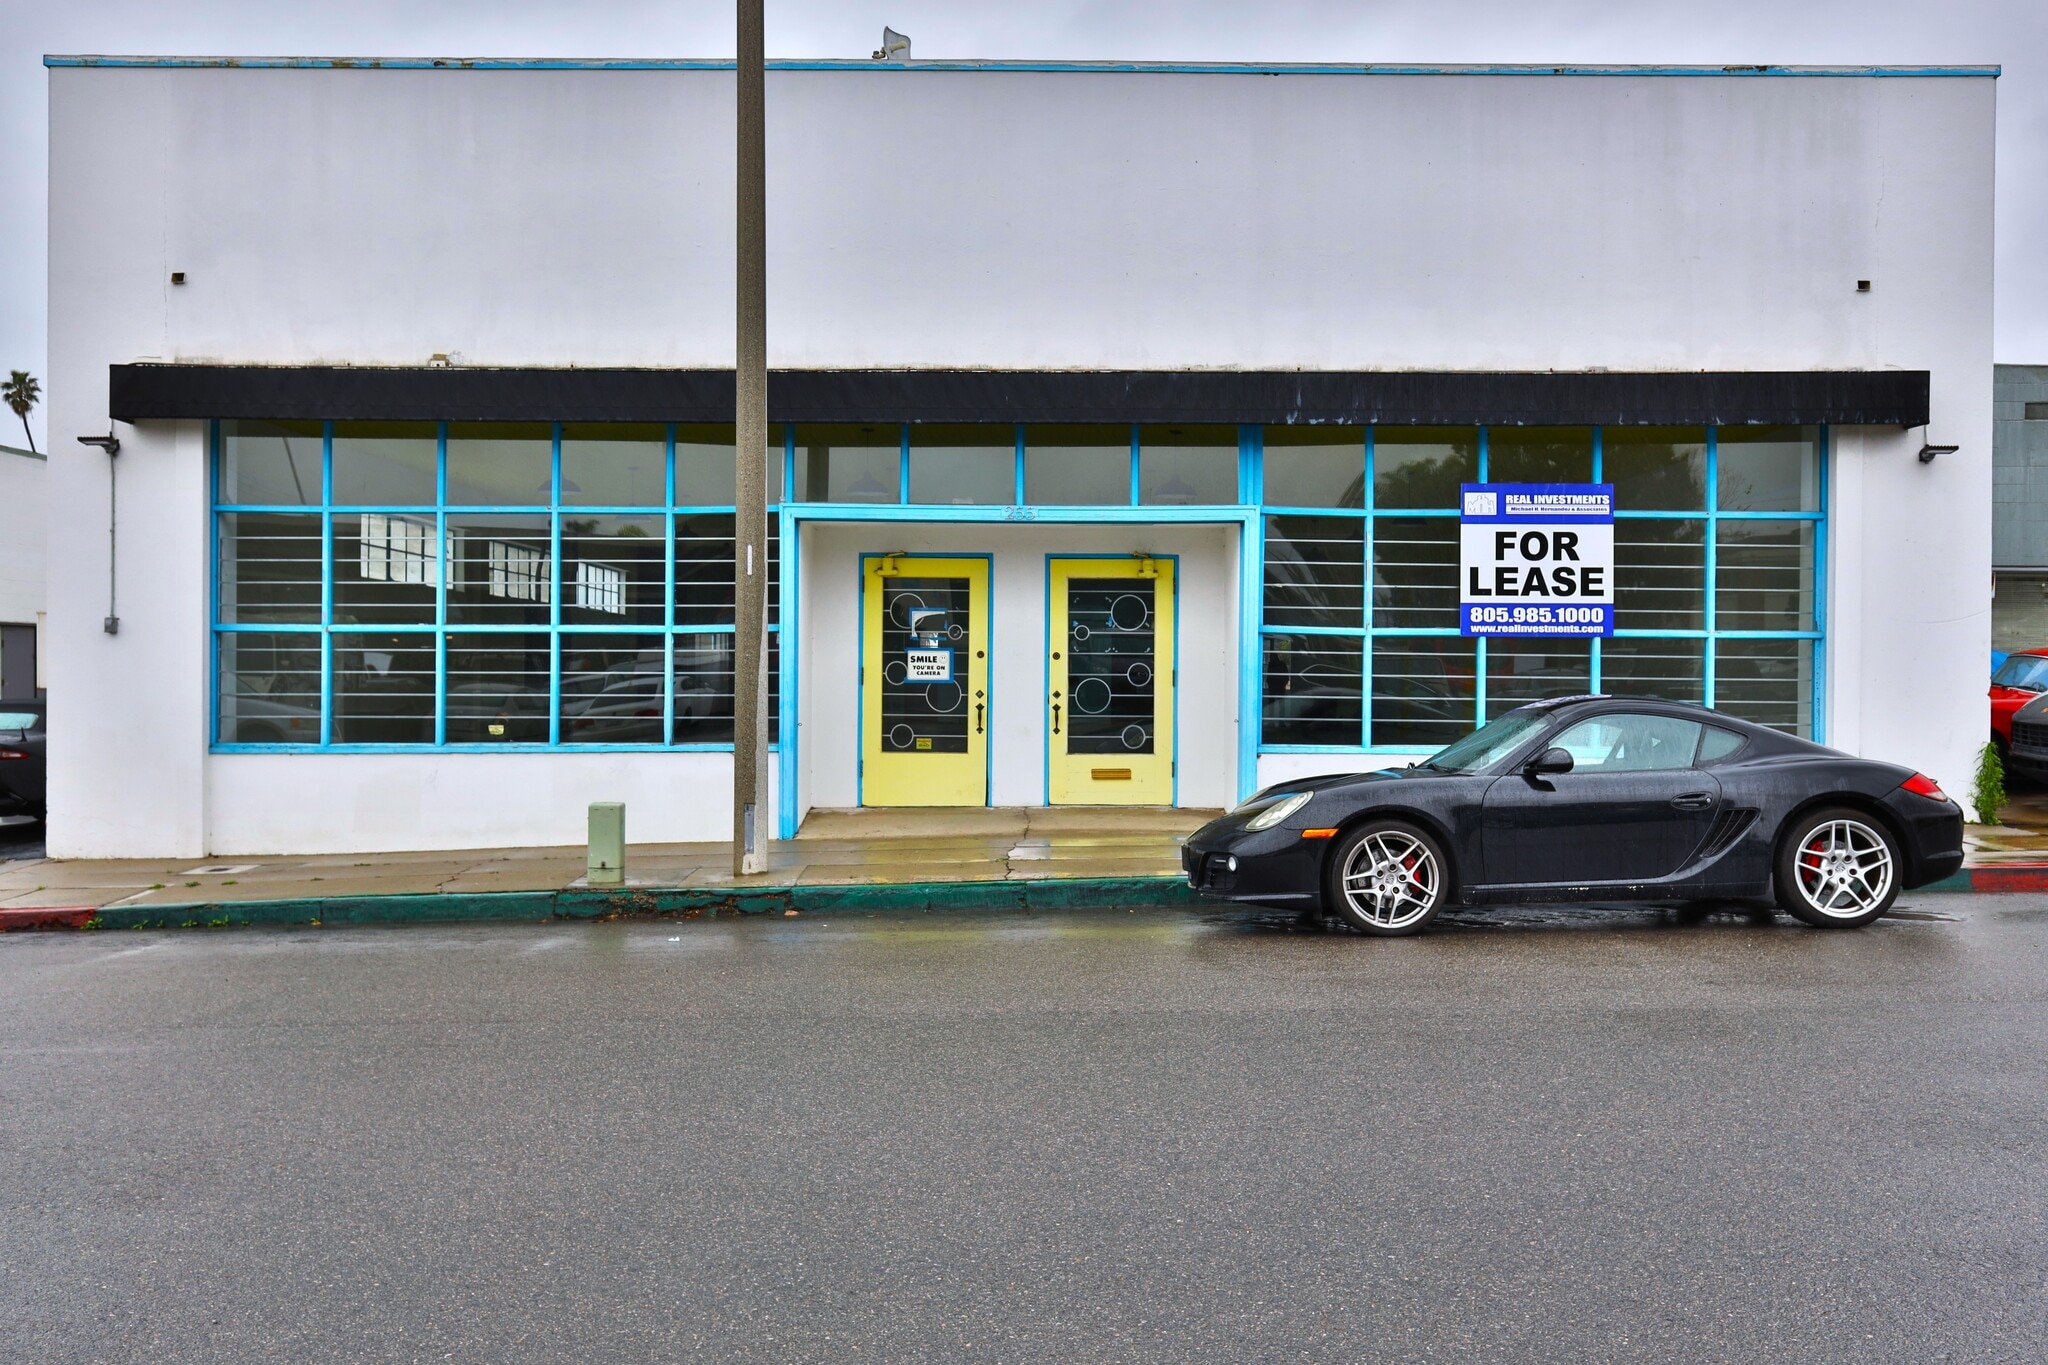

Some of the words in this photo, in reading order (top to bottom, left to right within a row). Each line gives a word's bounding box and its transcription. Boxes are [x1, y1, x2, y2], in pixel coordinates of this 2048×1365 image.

[1506, 495, 1532, 504] REAL
[1534, 495, 1610, 504] INVESTMENTS
[1495, 531, 1580, 561] FOR
[1469, 567, 1604, 596] LEASE
[1470, 607, 1604, 623] 805.985.1000
[1470, 624, 1604, 634] www.realinvestments.com
